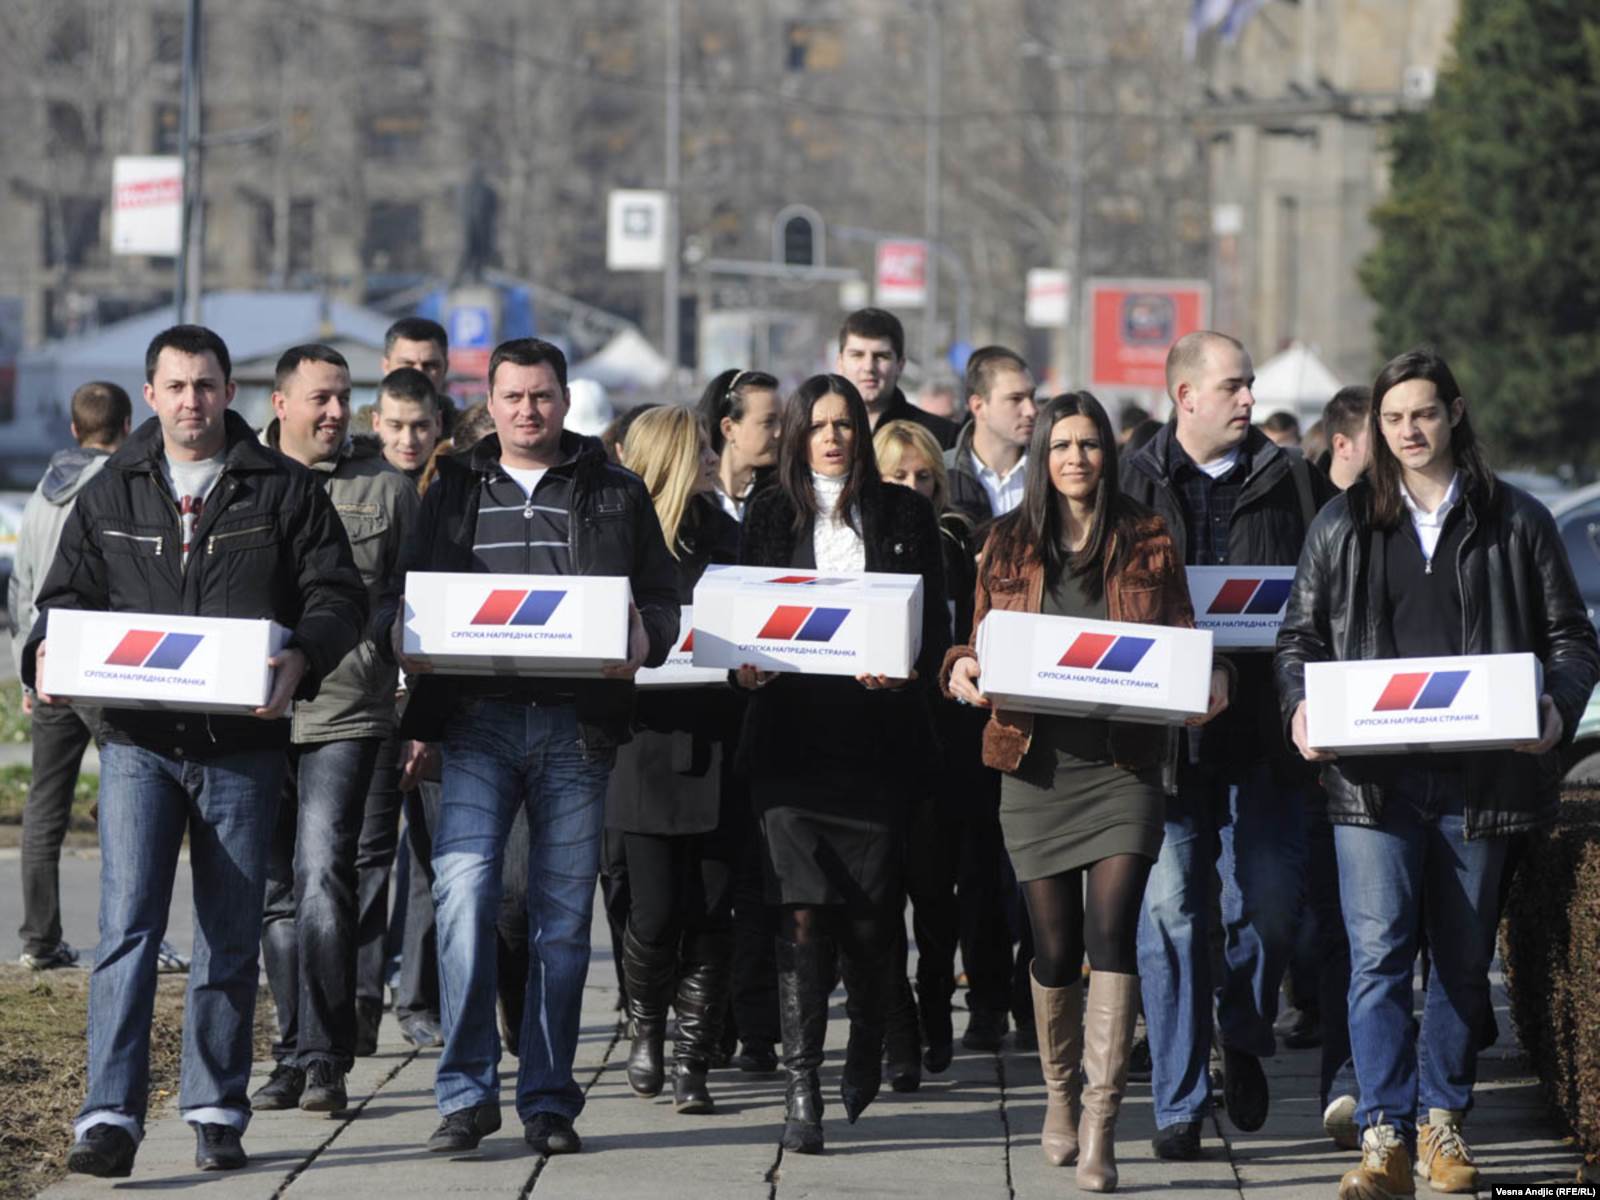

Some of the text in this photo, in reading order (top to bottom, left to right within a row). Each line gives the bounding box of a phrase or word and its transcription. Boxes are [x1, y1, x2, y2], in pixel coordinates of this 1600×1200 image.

[1222, 621, 1267, 629] НАПРЕДНА
[451, 631, 573, 640] СРПСКА НАПРЕДНА СТРАНКА
[738, 644, 857, 657] СРПСКА НАПРЕДНА СТРАНКА
[84, 670, 206, 686] СРПСКА НАПРЕДНА СТРАНКА
[1037, 671, 1159, 689] СРПСКА НАПРЕДНА СТРАНКА
[1354, 714, 1479, 726] СРПСКА НАПРЕДНА СТРАНКА
